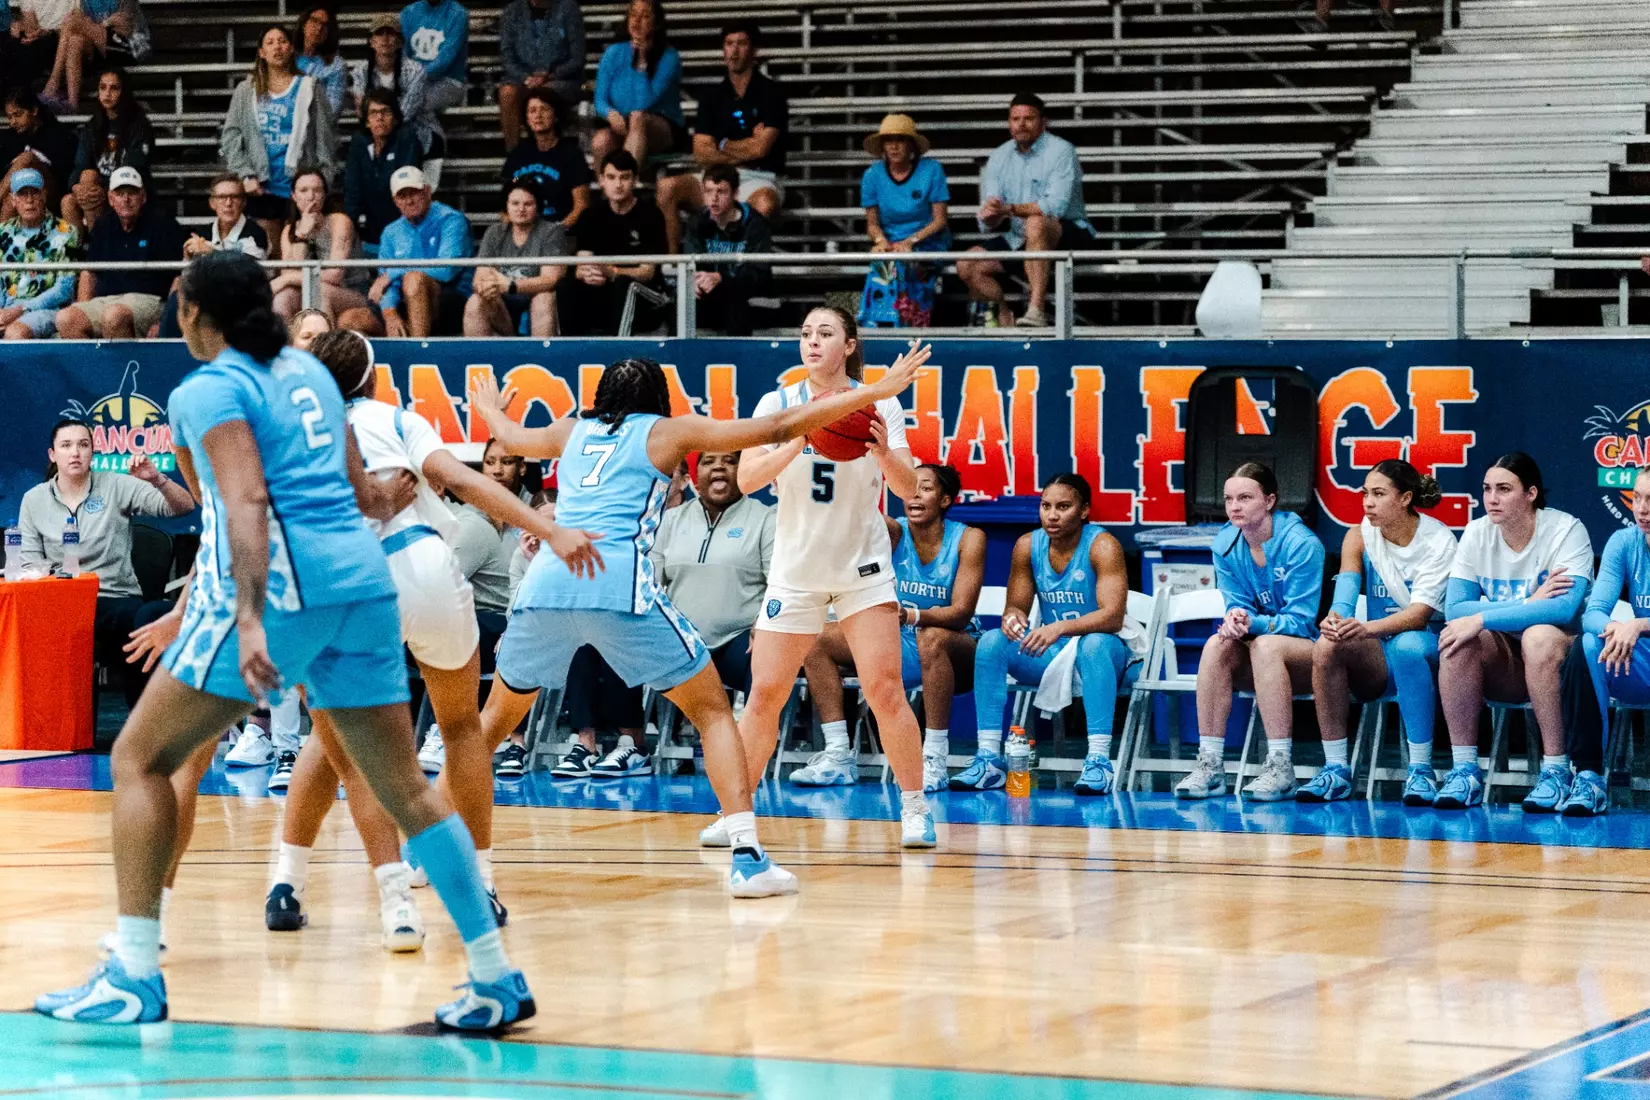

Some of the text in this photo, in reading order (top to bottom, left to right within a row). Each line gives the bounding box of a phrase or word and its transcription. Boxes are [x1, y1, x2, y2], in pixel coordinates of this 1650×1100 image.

[290, 386, 334, 450] 2
[581, 442, 618, 487] 7
[811, 461, 836, 503] 5
[900, 580, 947, 600] NORTH
[1040, 590, 1086, 605] NORTH
